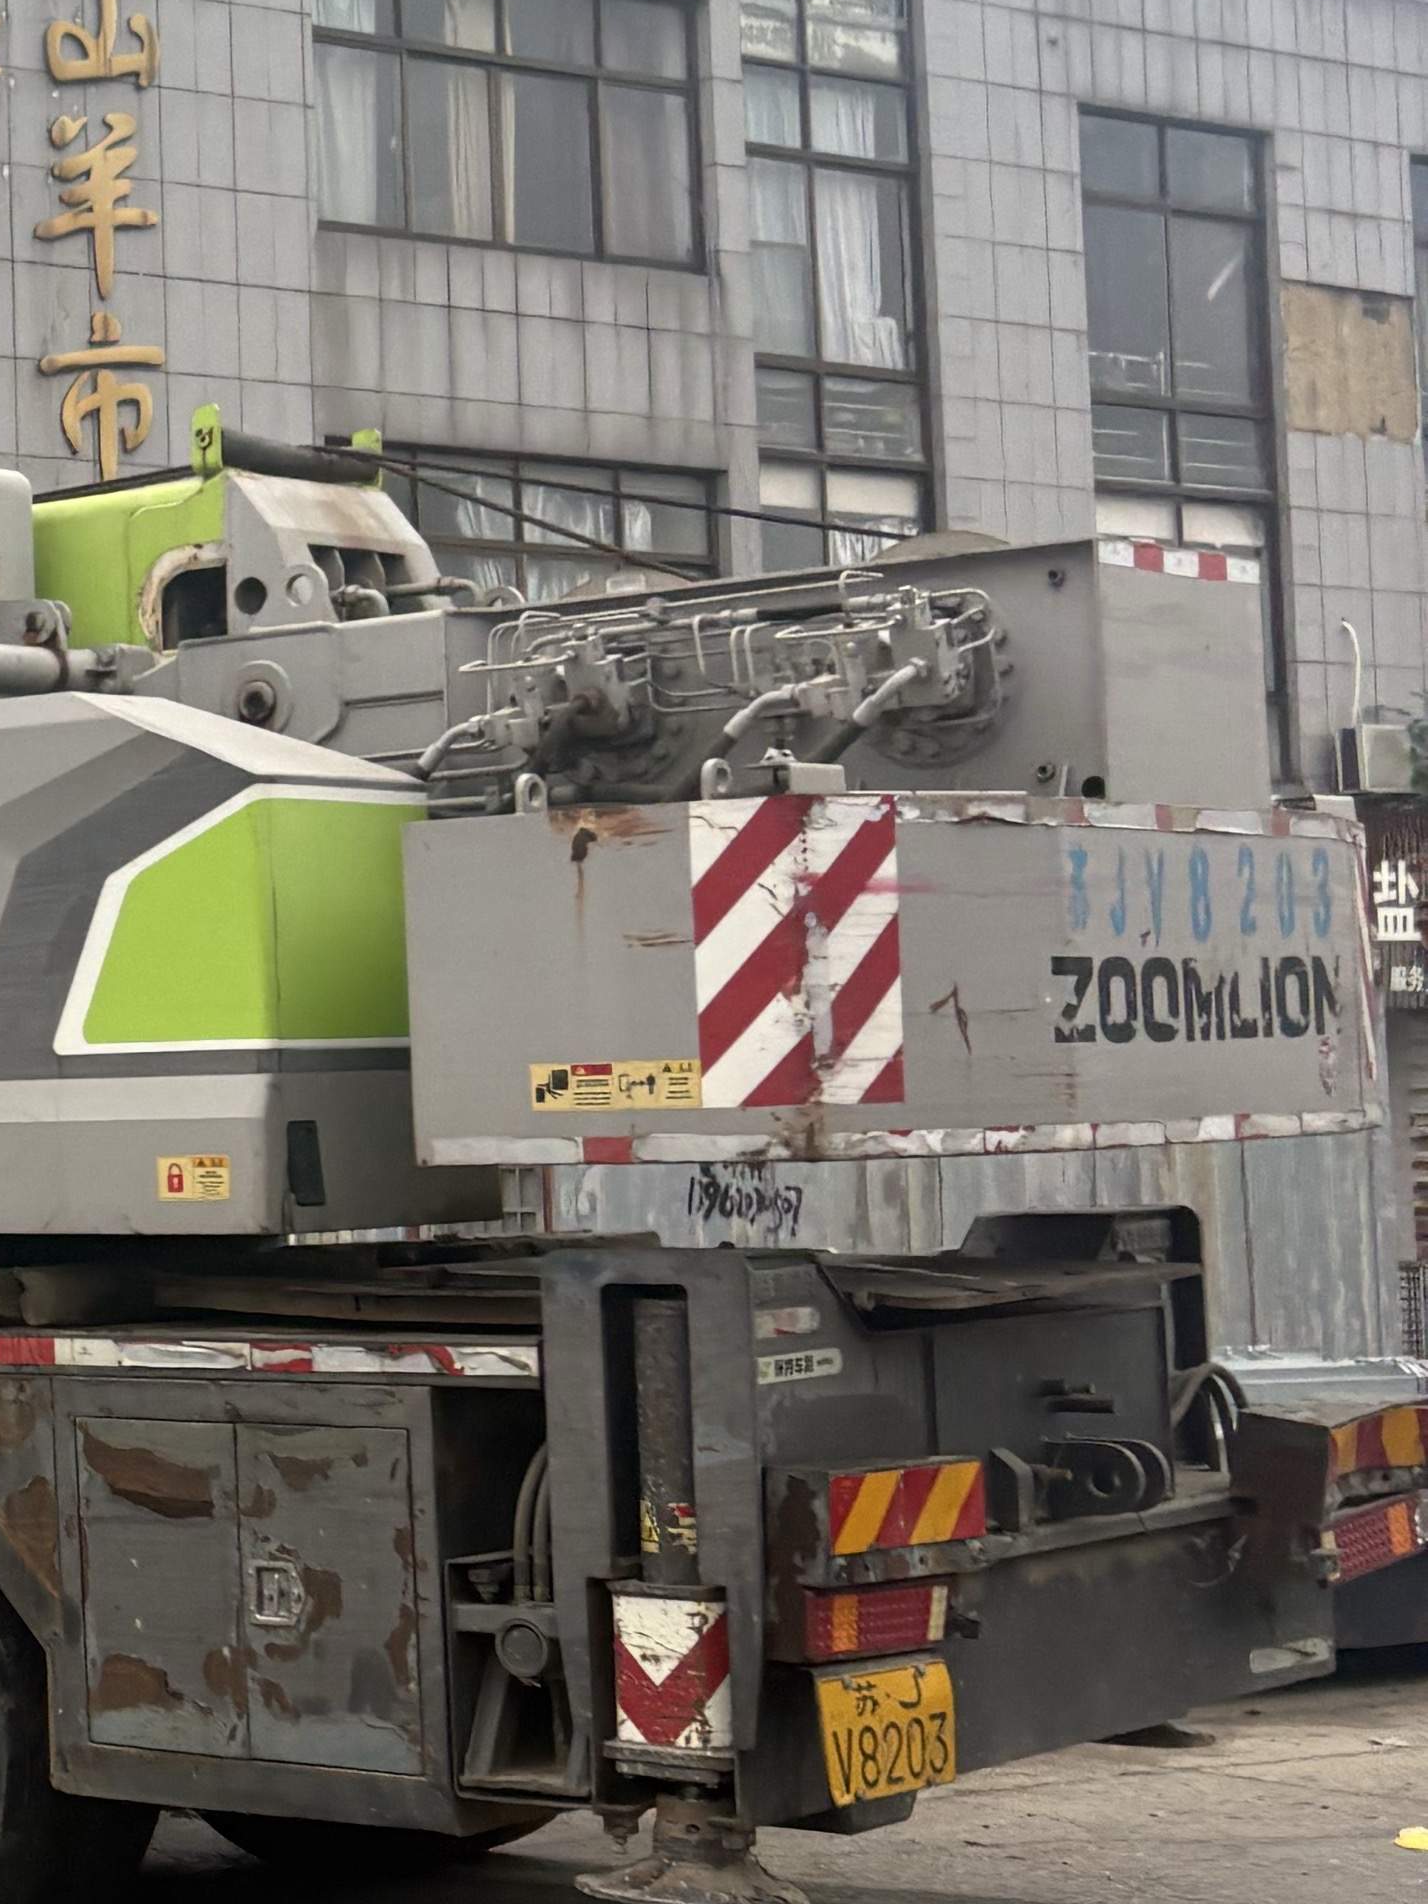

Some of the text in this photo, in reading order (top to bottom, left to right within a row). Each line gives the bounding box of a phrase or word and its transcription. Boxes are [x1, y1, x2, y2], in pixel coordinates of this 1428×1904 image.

[1372, 860, 1423, 942] 盐
[1050, 955, 1342, 1044] ZOOMLION
[831, 1711, 949, 1795] V8203
